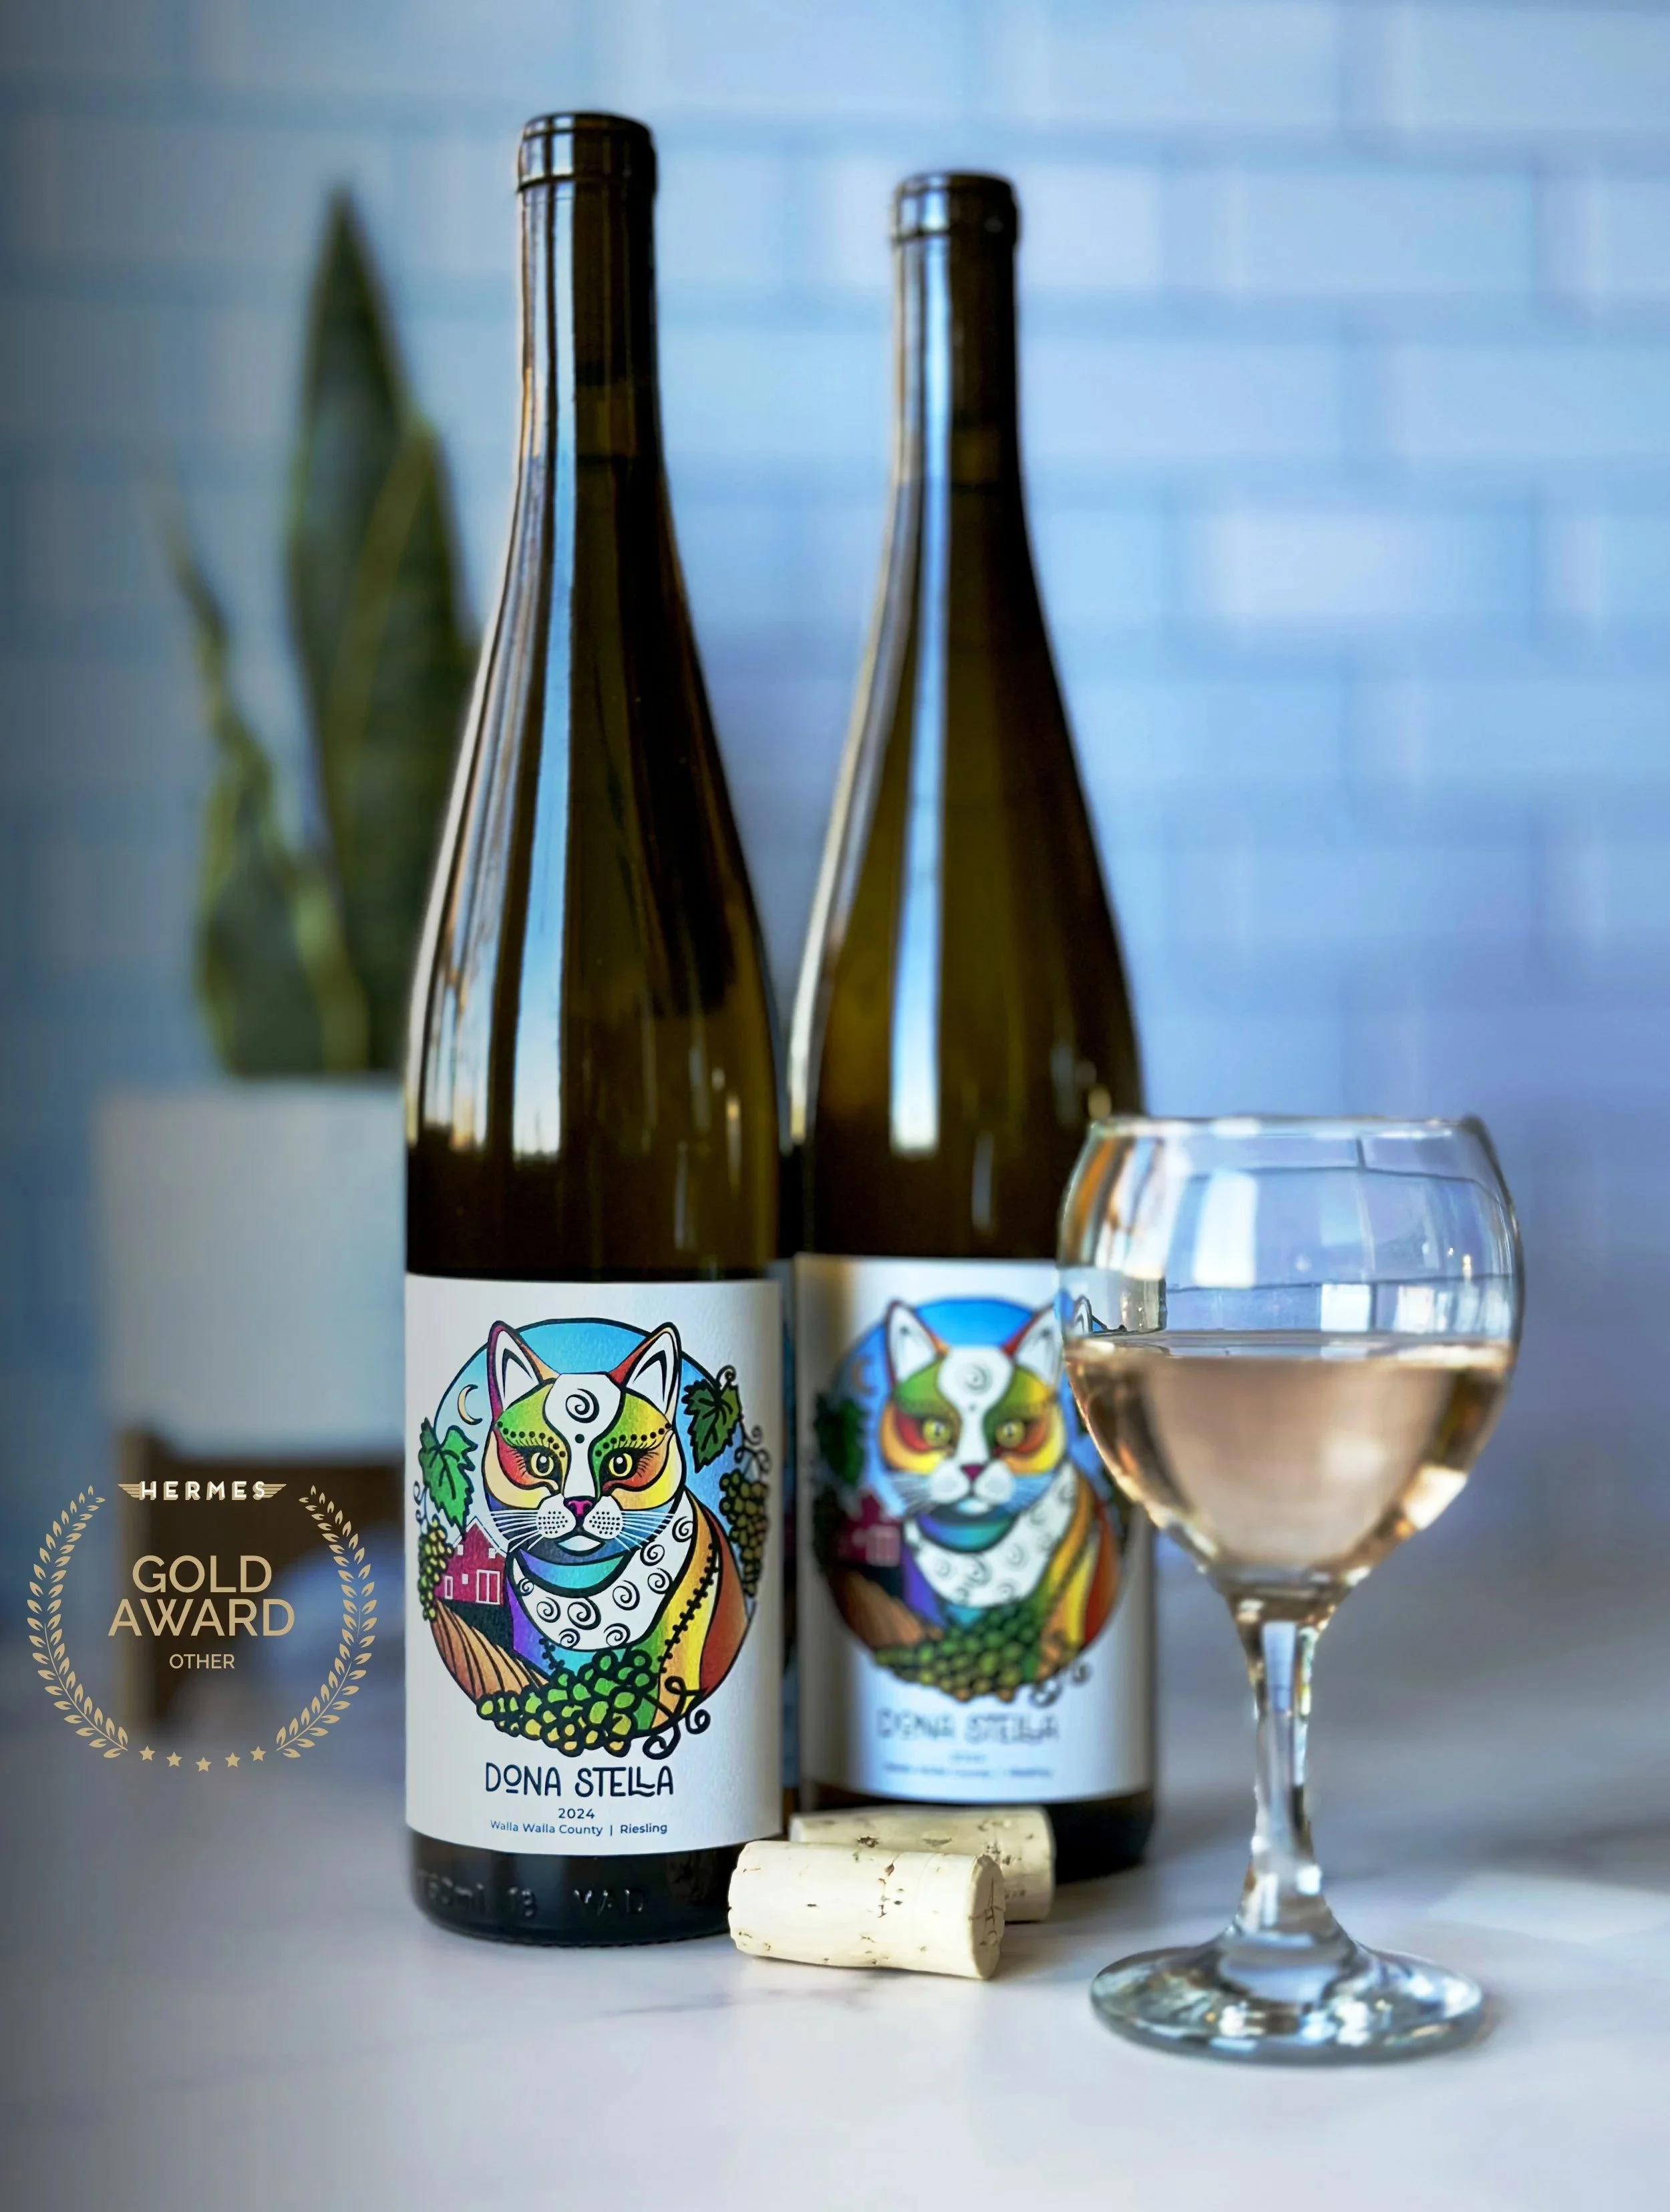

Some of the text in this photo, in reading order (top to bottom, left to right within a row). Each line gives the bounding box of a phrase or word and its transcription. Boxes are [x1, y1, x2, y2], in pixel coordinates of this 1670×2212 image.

[485, 1762, 674, 1798] DONA STELLA
[558, 1808, 596, 1819] 2024
[490, 1819, 519, 1832] Walla
[522, 1823, 556, 1834] Walla
[558, 1824, 603, 1837] County
[620, 1823, 668, 1835] Riesling
